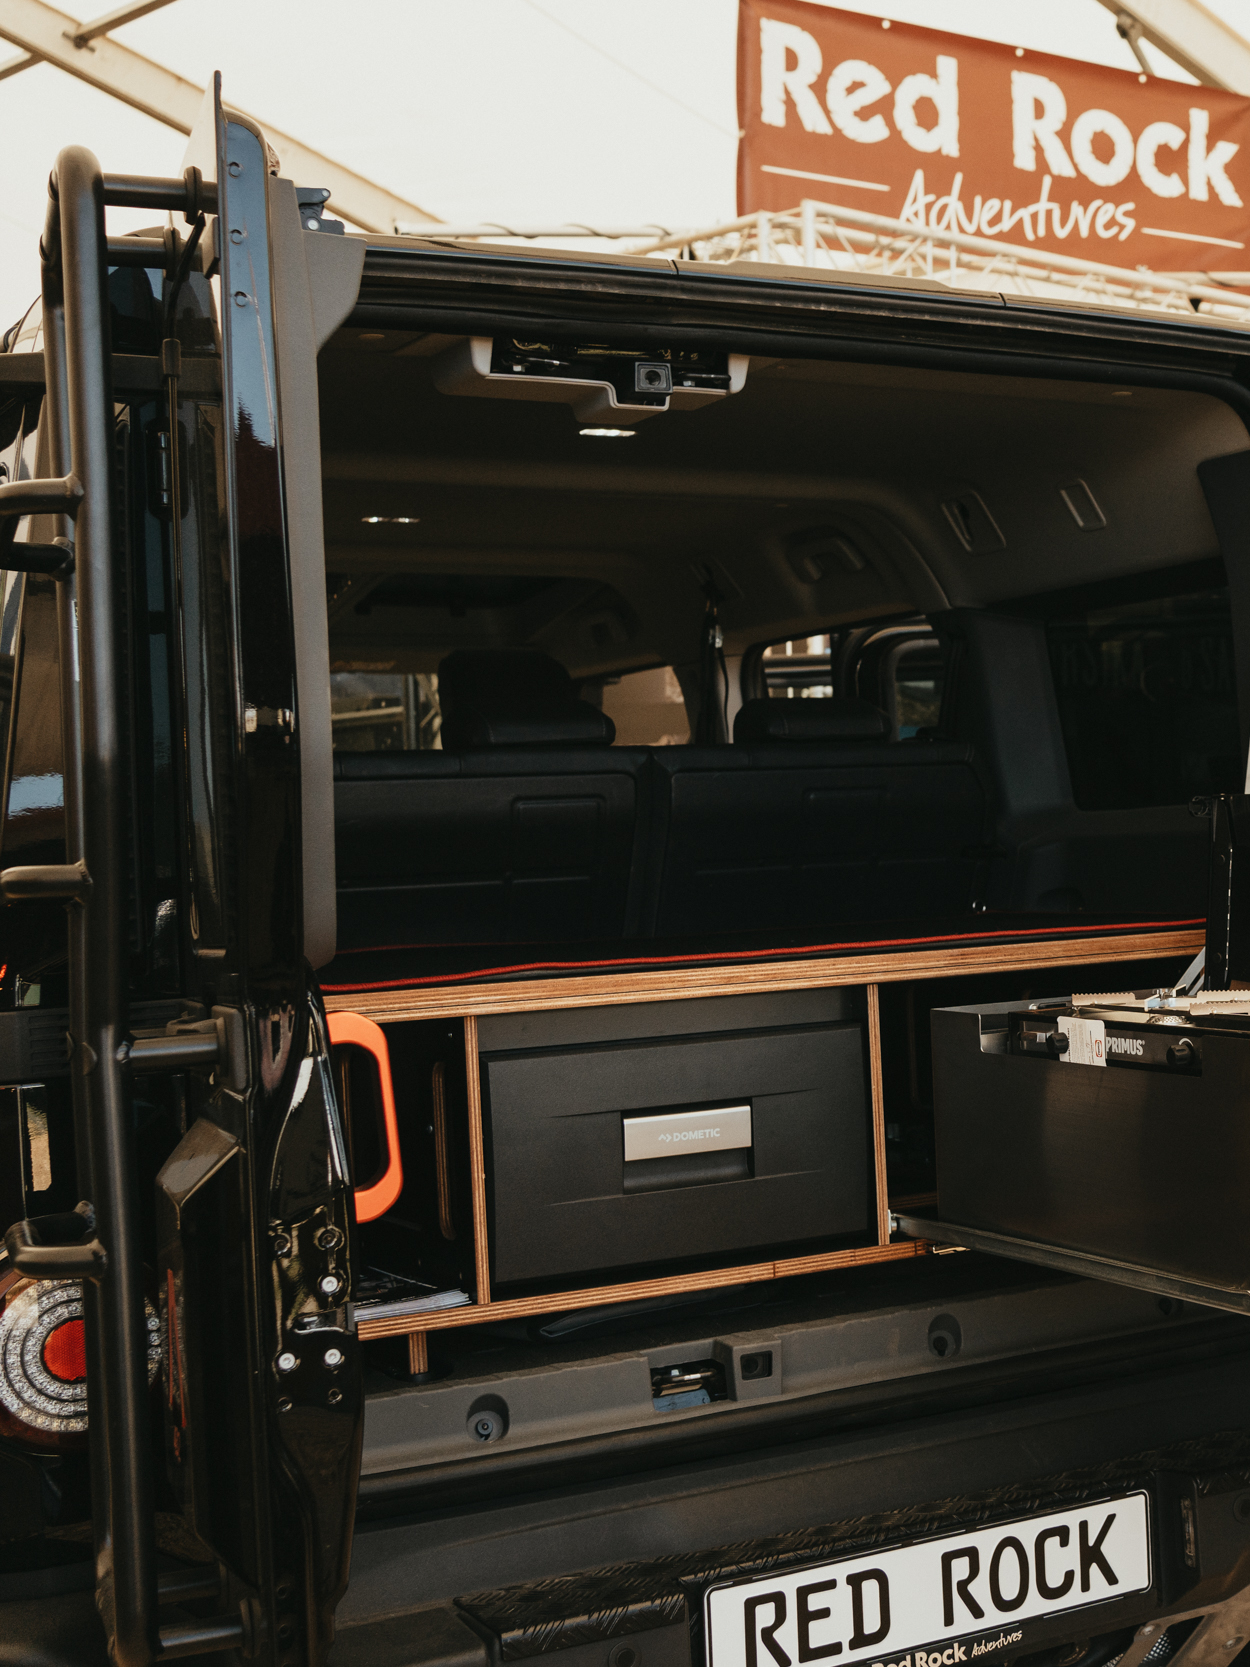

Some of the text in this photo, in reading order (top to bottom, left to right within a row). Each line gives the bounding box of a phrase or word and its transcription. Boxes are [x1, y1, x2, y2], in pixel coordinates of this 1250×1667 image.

[760, 17, 1243, 208] Red Rock
[899, 169, 1136, 242] Adventures
[674, 1129, 721, 1142] DOMETIC
[743, 1513, 1119, 1667] RED ROCK
[915, 1643, 967, 1667] Rock
[972, 1630, 1023, 1658] Adventures
